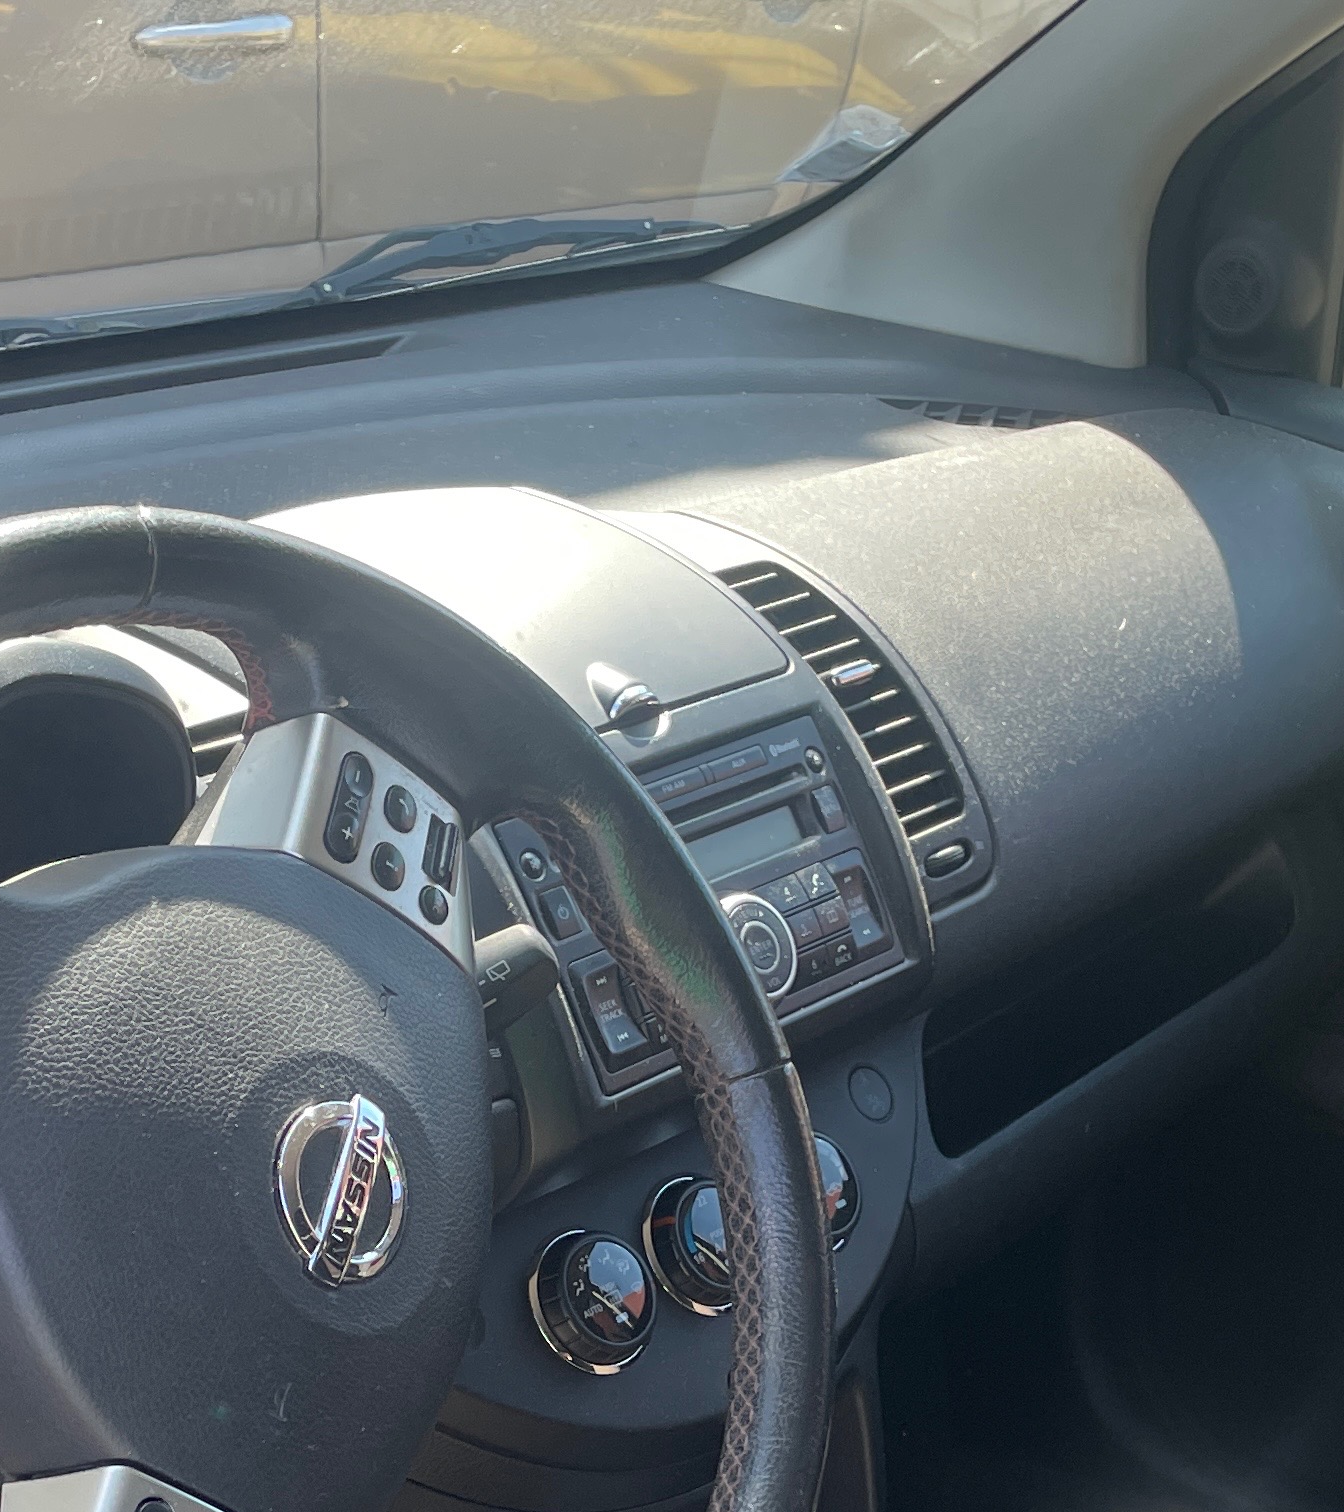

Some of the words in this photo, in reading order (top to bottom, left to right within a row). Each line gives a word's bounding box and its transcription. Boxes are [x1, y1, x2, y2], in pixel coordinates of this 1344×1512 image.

[598, 999, 617, 1012] SEEK
[600, 1008, 624, 1023] TRACK
[322, 1115, 382, 1270] NISSAN
[583, 1303, 604, 1319] AUTO
